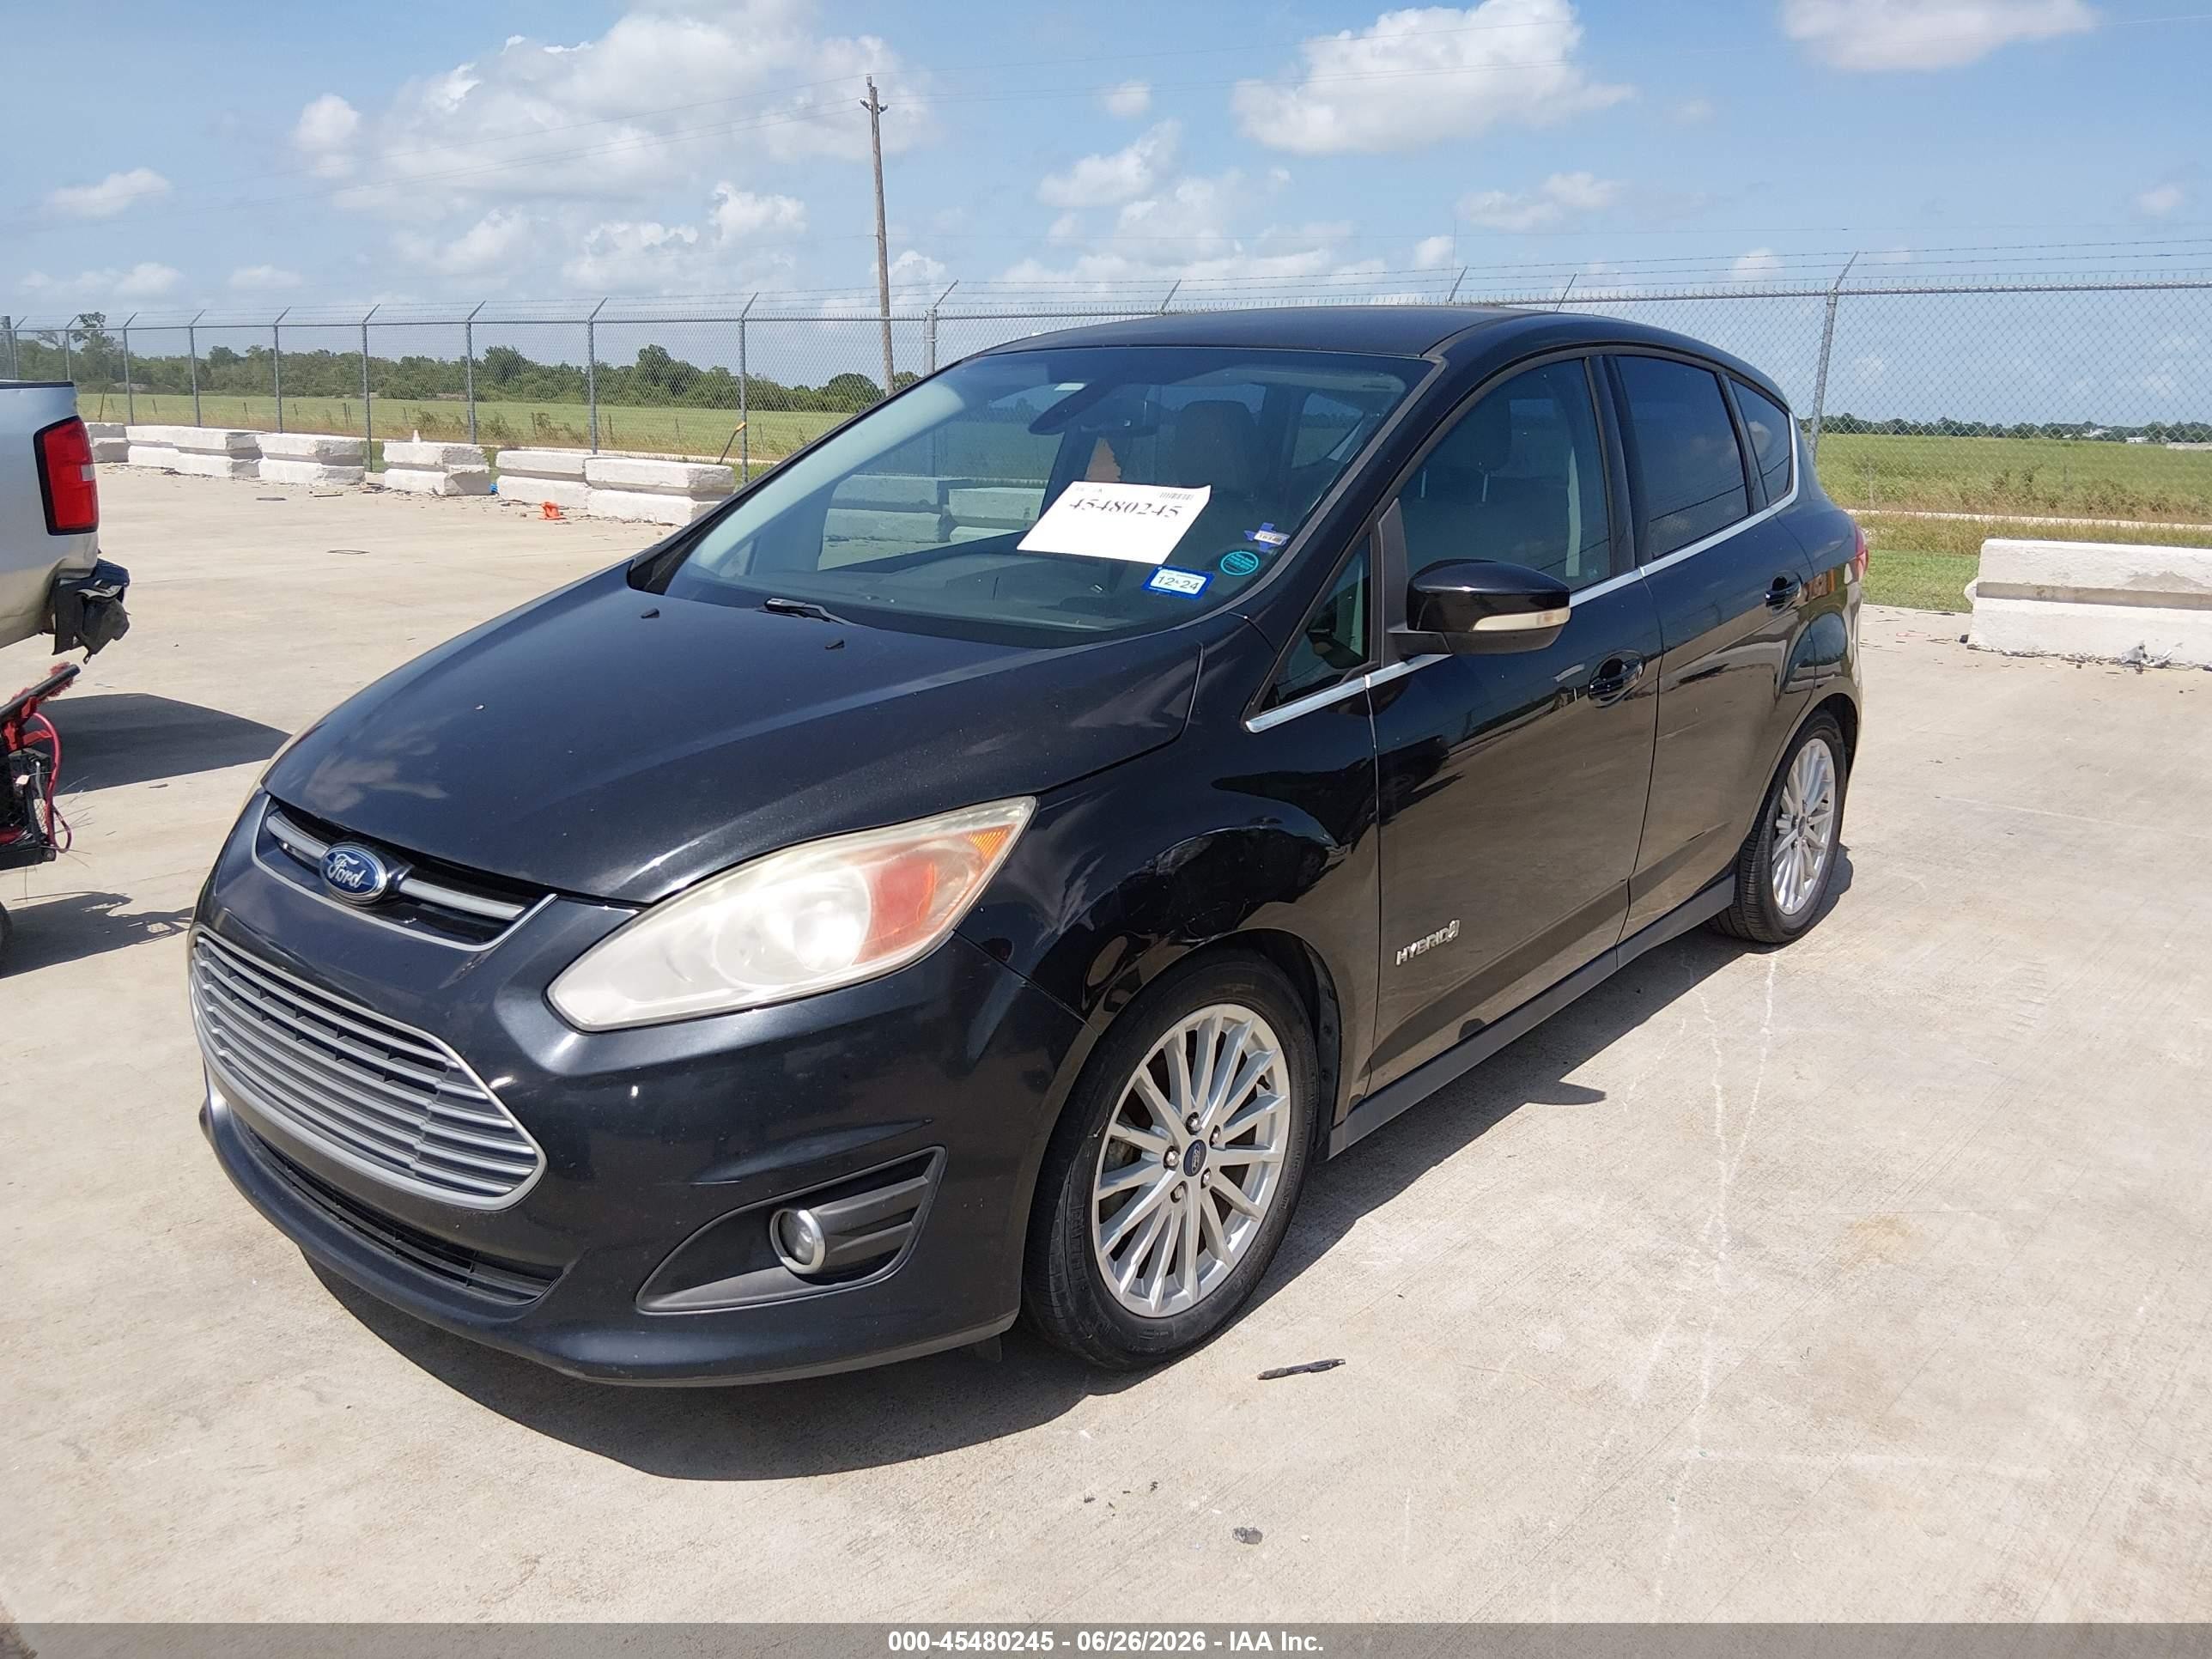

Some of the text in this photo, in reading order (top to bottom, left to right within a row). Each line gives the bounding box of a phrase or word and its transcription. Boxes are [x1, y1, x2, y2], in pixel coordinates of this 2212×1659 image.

[1069, 498, 1182, 518] 45480245
[327, 853, 367, 889] Ford
[1395, 927, 1450, 966] HYBRID
